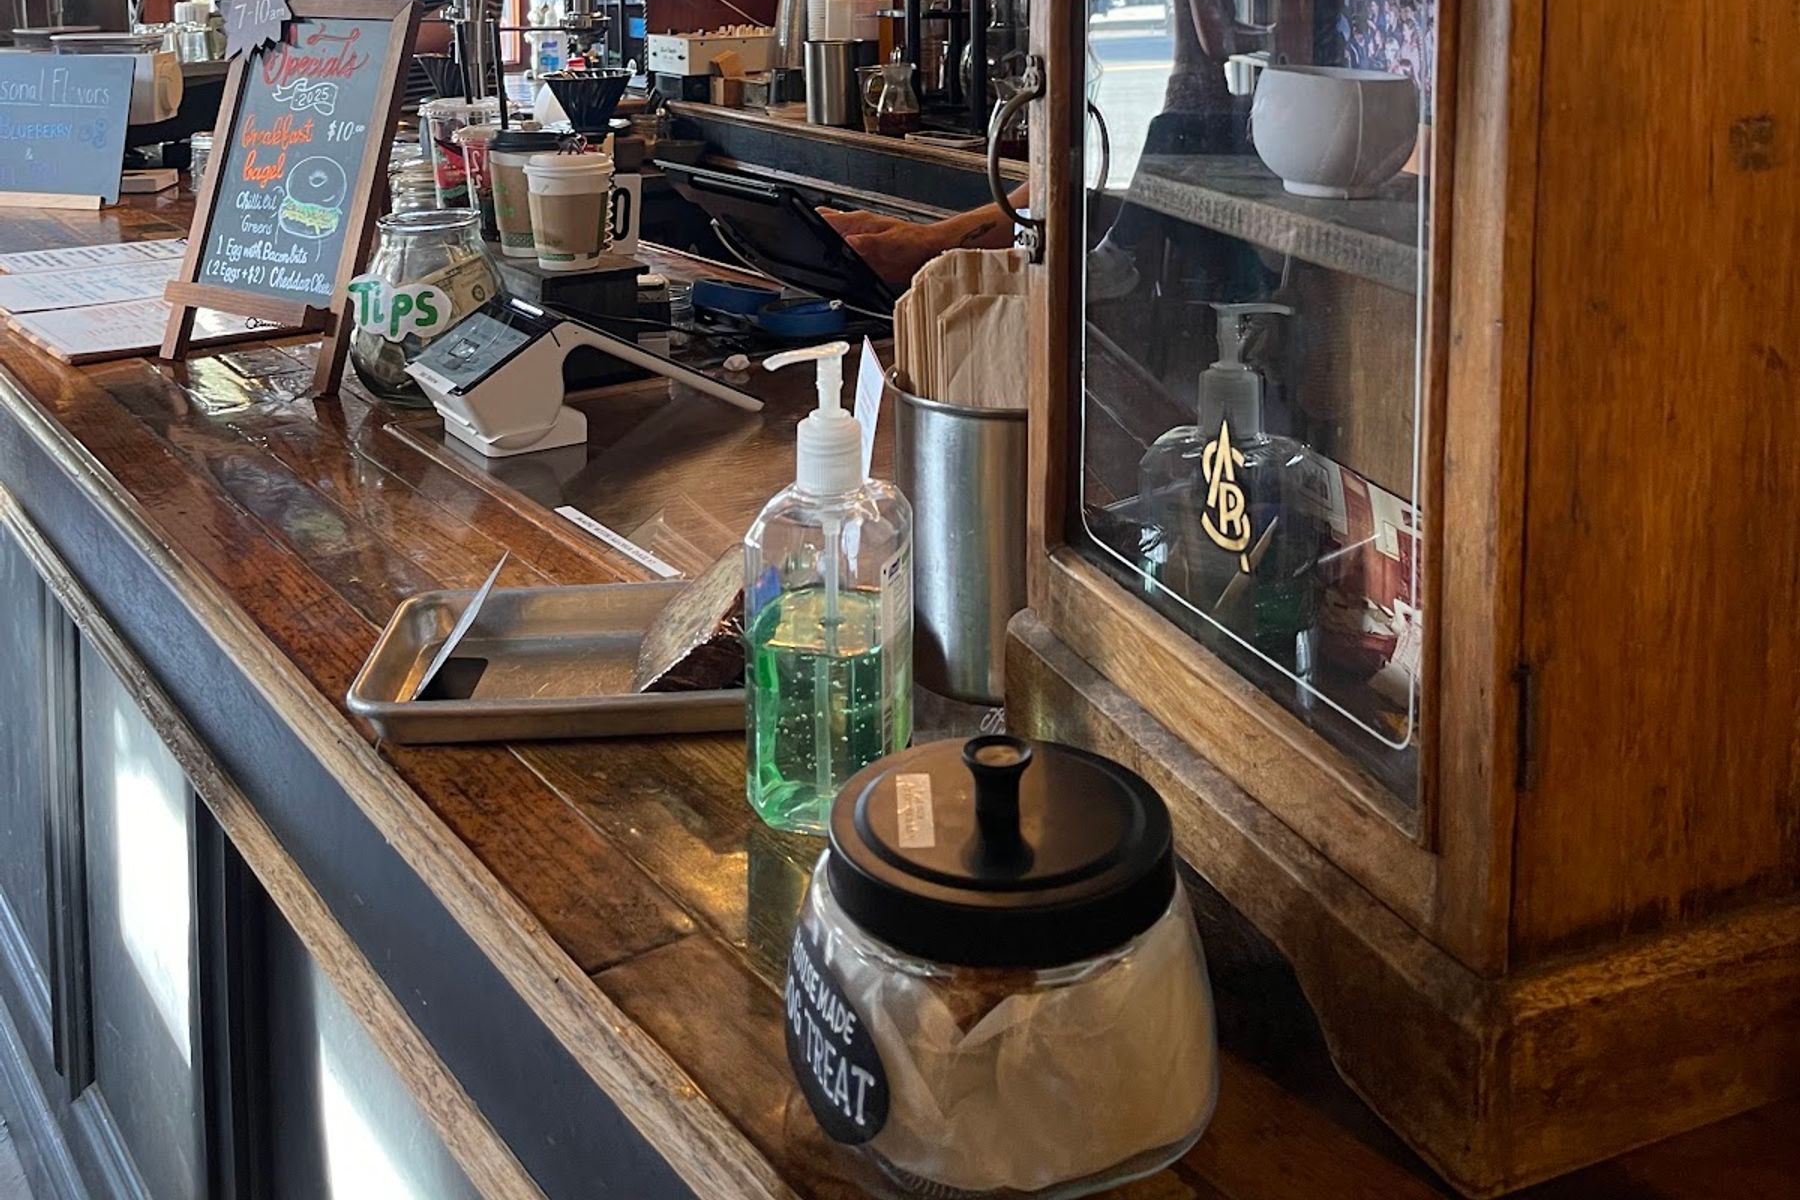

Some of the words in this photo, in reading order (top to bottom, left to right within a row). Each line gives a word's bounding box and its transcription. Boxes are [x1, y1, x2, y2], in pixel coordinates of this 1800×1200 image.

[298, 87, 329, 107] 2025
[242, 150, 286, 188] bagel
[215, 234, 224, 255] 1
[226, 238, 242, 262] Egg
[803, 1007, 876, 1126] TREAT
